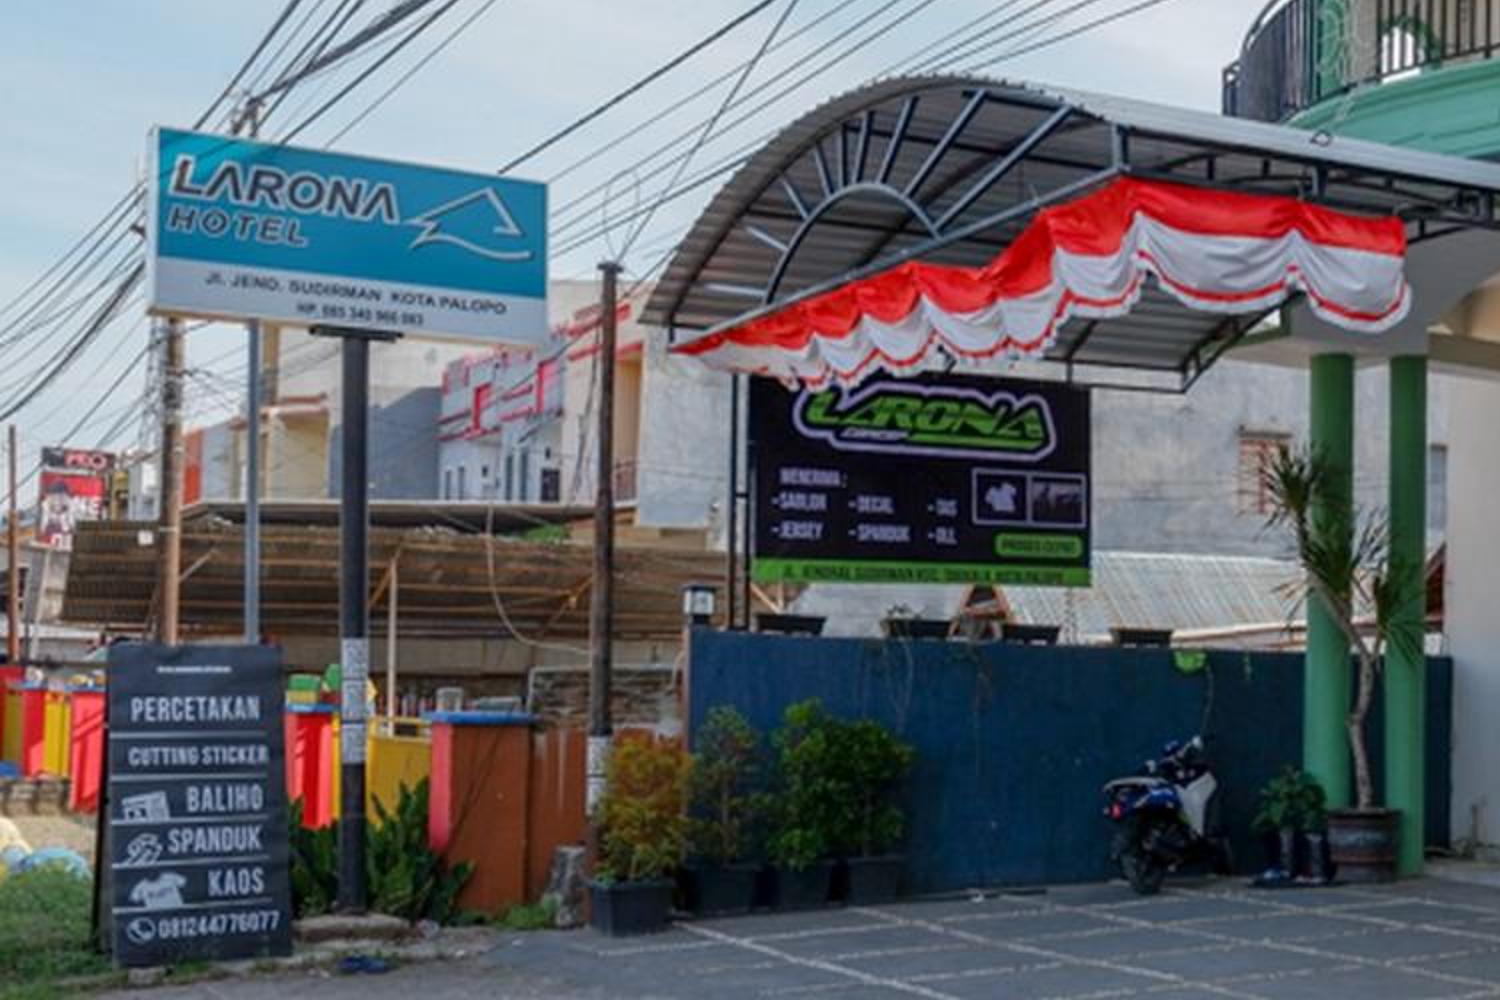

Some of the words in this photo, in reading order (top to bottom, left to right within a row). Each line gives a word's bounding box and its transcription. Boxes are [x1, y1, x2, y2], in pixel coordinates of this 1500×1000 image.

[168, 153, 400, 226] LARONA
[165, 203, 309, 248] HOTEL
[438, 295, 508, 316] PALOPO
[805, 388, 1046, 440] LARONA
[130, 696, 261, 723] PERCETAKAN
[128, 746, 199, 767] CUTTING
[201, 744, 269, 765] STICKER
[186, 784, 263, 813] BALIHO
[167, 823, 263, 854] SPANDUK
[207, 868, 265, 897] KAOS
